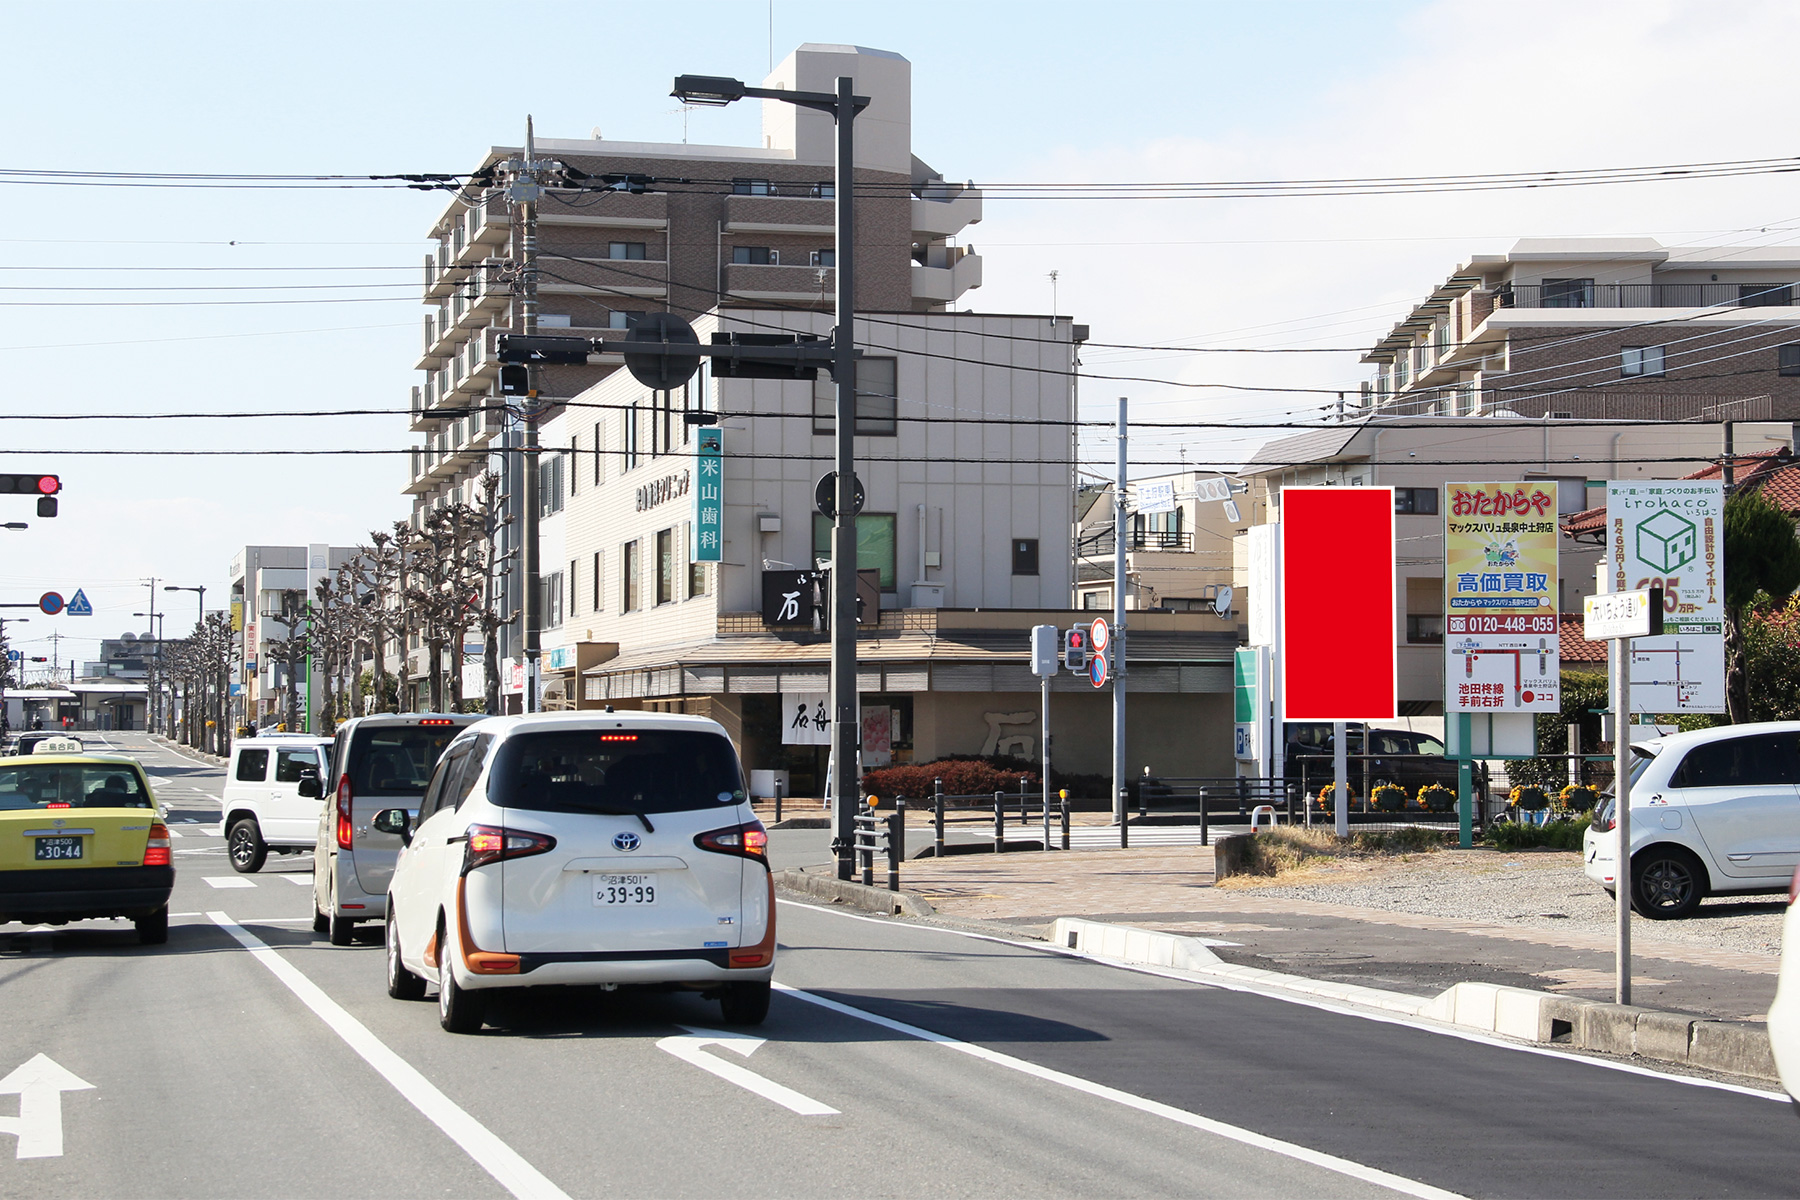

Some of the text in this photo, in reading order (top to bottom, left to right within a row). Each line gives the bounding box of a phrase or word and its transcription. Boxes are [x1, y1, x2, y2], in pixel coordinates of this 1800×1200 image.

[701, 459, 719, 549] 米山歯科
[1452, 489, 1552, 517] おたからや
[1625, 497, 1708, 508] irohaco
[1686, 508, 1718, 516] いろはこ
[1449, 522, 1554, 533] マックスバリュ長泉中土狩店
[1704, 517, 1717, 604] 自由設計のマイホーム
[1457, 572, 1548, 592] 高価買取
[1469, 617, 1554, 632] 0120-448-055
[1095, 628, 1104, 643] 40
[1459, 683, 1504, 694] 池田柊線
[1459, 696, 1504, 707] 手前右折
[1537, 693, 1554, 701] ココ
[45, 846, 81, 858] 30-44
[607, 886, 655, 904] 39-99
